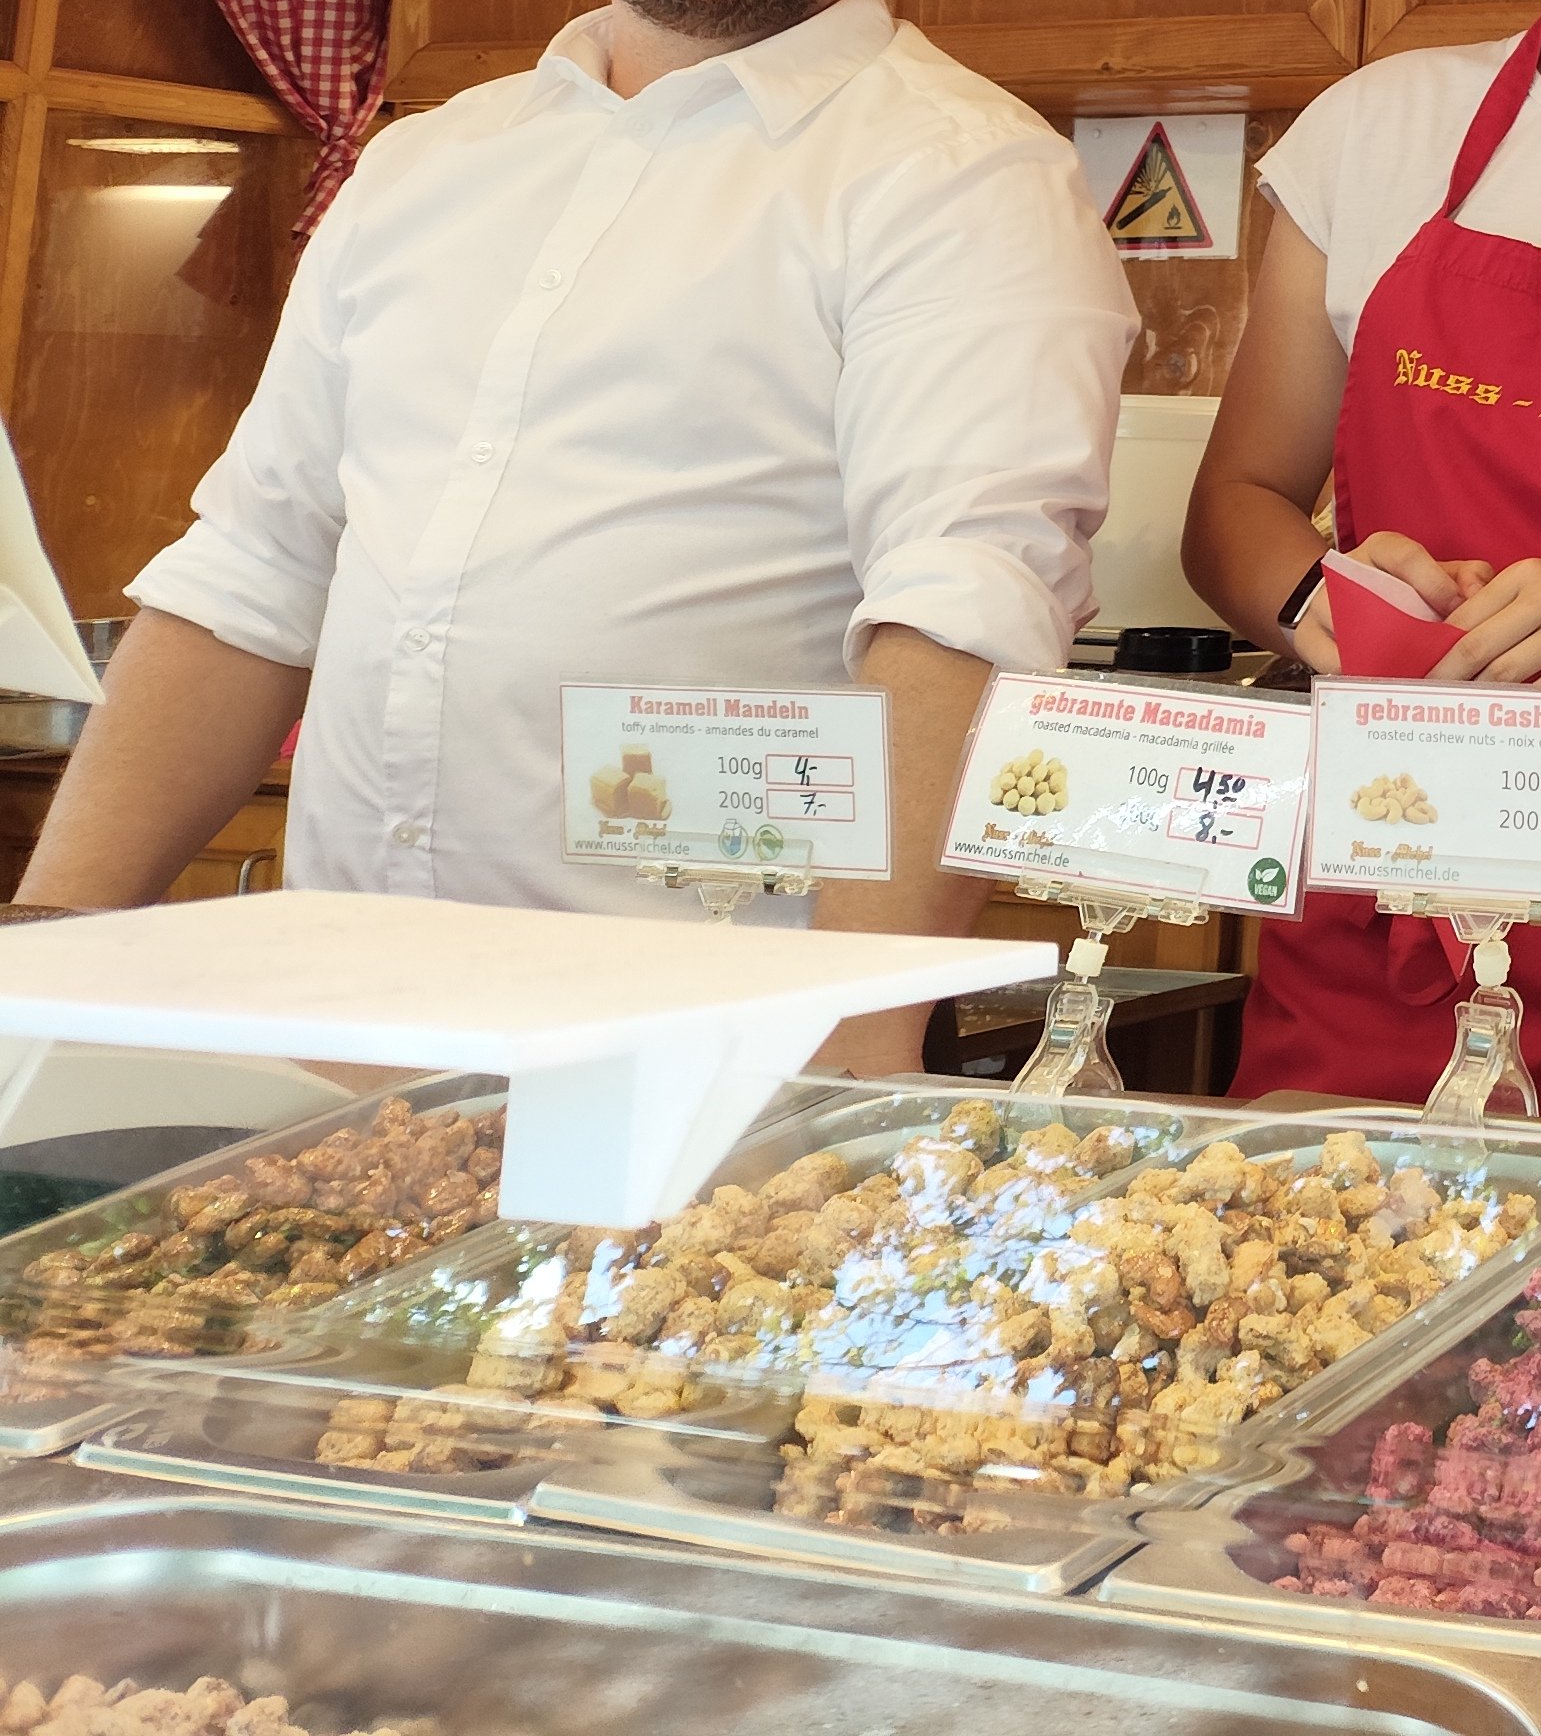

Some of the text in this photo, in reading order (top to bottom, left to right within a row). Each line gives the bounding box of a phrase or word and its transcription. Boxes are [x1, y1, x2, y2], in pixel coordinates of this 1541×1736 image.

[1394, 348, 1502, 406] Nuss
[629, 695, 810, 720] Karamell Mandeln
[1029, 691, 1267, 739] gebrannte Macadamia
[1355, 698, 1481, 727] gebrannte
[621, 721, 819, 740] toffy almonds amandes du caramel
[1032, 718, 1236, 755] roasted macadamia macadamia grillée
[1367, 728, 1414, 742] roasted
[1418, 730, 1464, 745] cashew
[1468, 733, 1496, 746] nuts
[1508, 734, 1534, 749] noix
[717, 756, 763, 779] 100g
[1129, 765, 1170, 794] 100g
[719, 790, 764, 814] 200g
[1321, 862, 1460, 882] www.nussmichel.de
[1254, 883, 1278, 897] VEGAN
